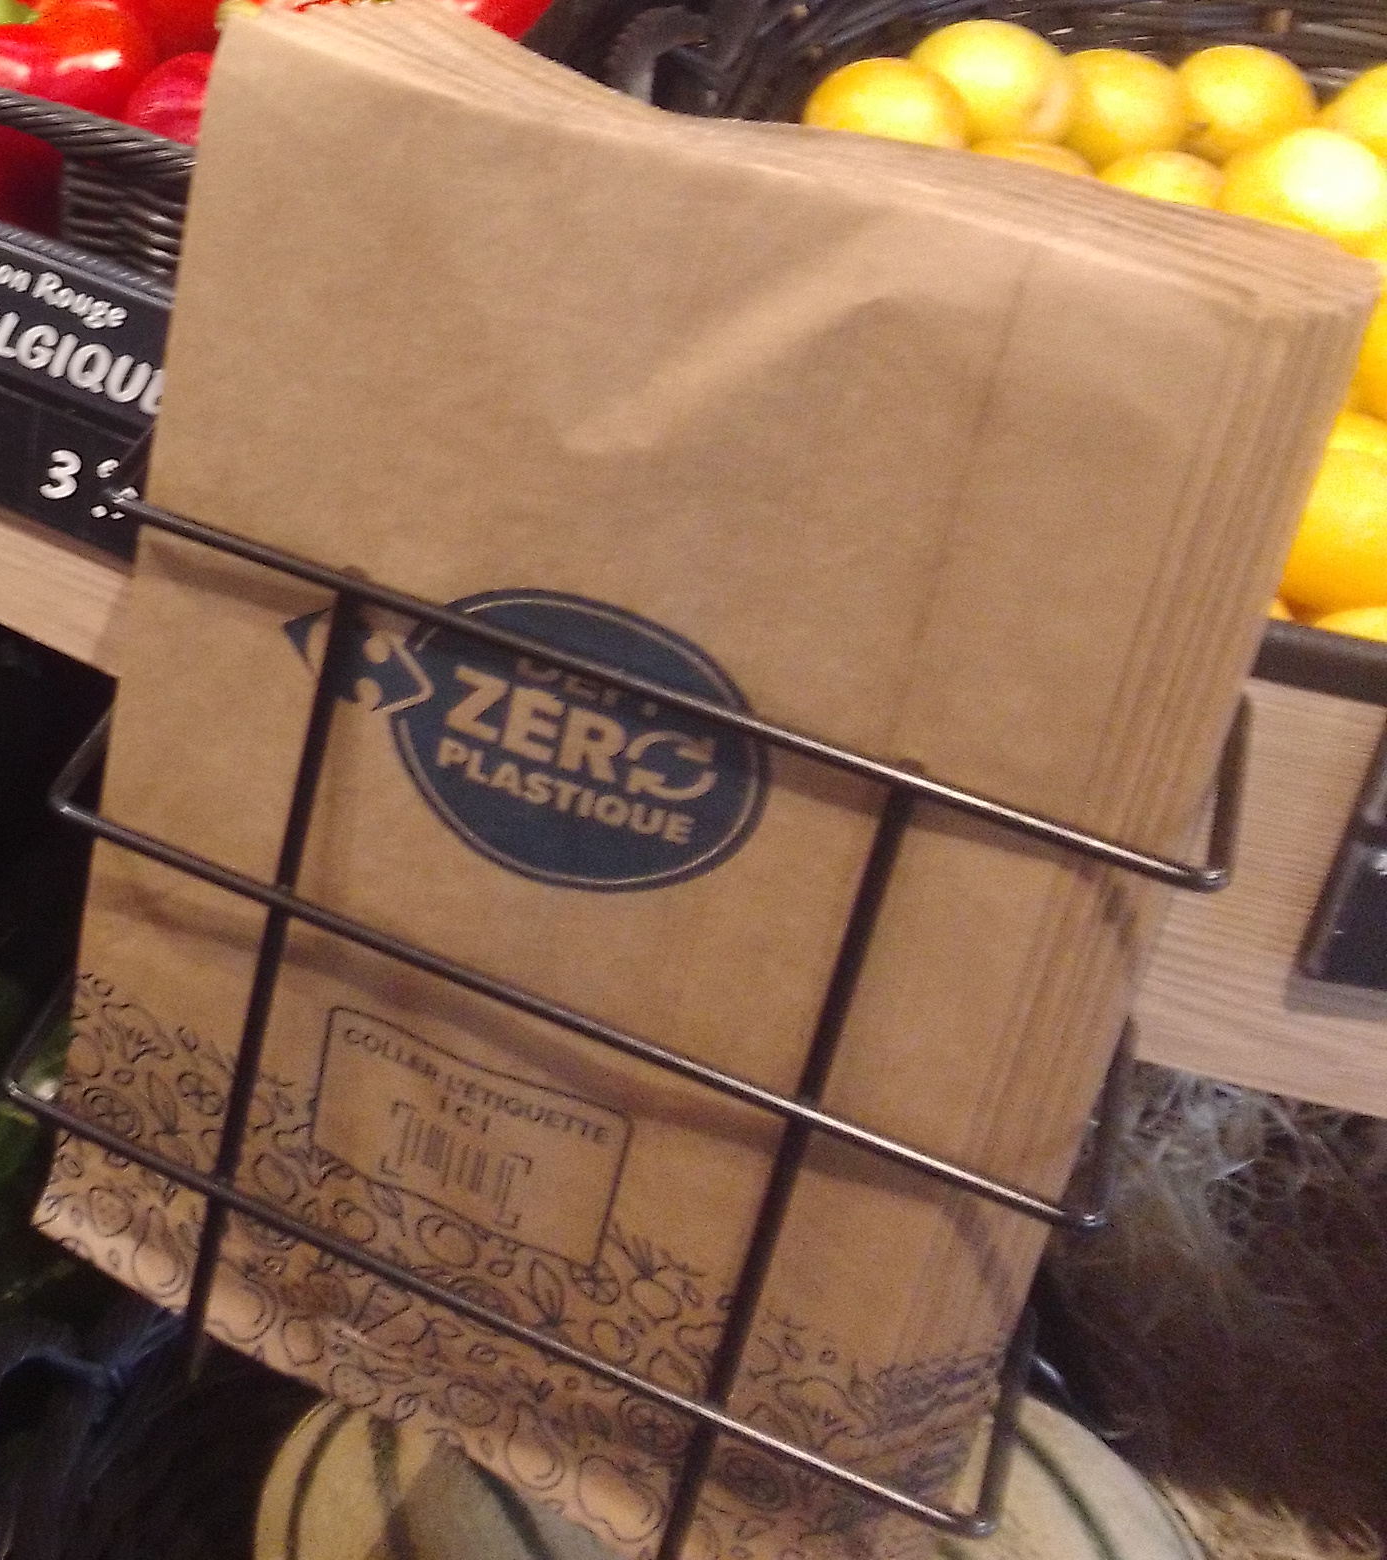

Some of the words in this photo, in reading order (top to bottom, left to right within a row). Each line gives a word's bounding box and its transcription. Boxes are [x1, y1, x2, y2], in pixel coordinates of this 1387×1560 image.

[30, 270, 129, 330] Rouge
[436, 736, 696, 845] PLASTIQUE
[344, 1028, 437, 1081] COLLER
